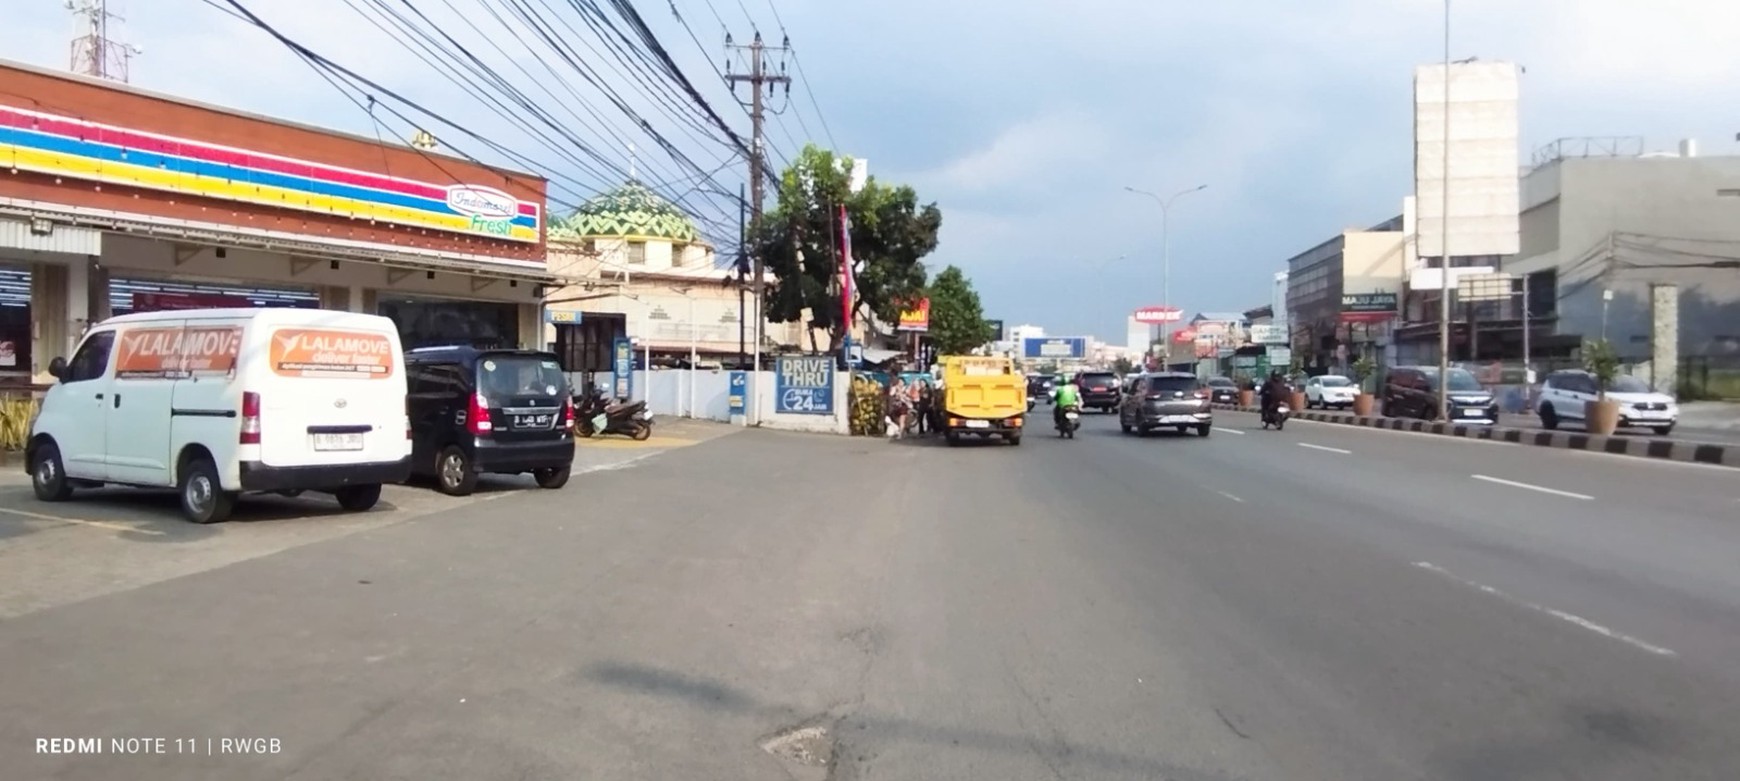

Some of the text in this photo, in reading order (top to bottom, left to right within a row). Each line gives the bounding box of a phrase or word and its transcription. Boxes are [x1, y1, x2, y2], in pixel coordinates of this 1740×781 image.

[301, 336, 389, 355] LALAMOVE
[312, 351, 350, 364] deliver
[782, 359, 830, 373] DRIVE
[782, 372, 828, 387] THRU
[793, 395, 813, 411] 24
